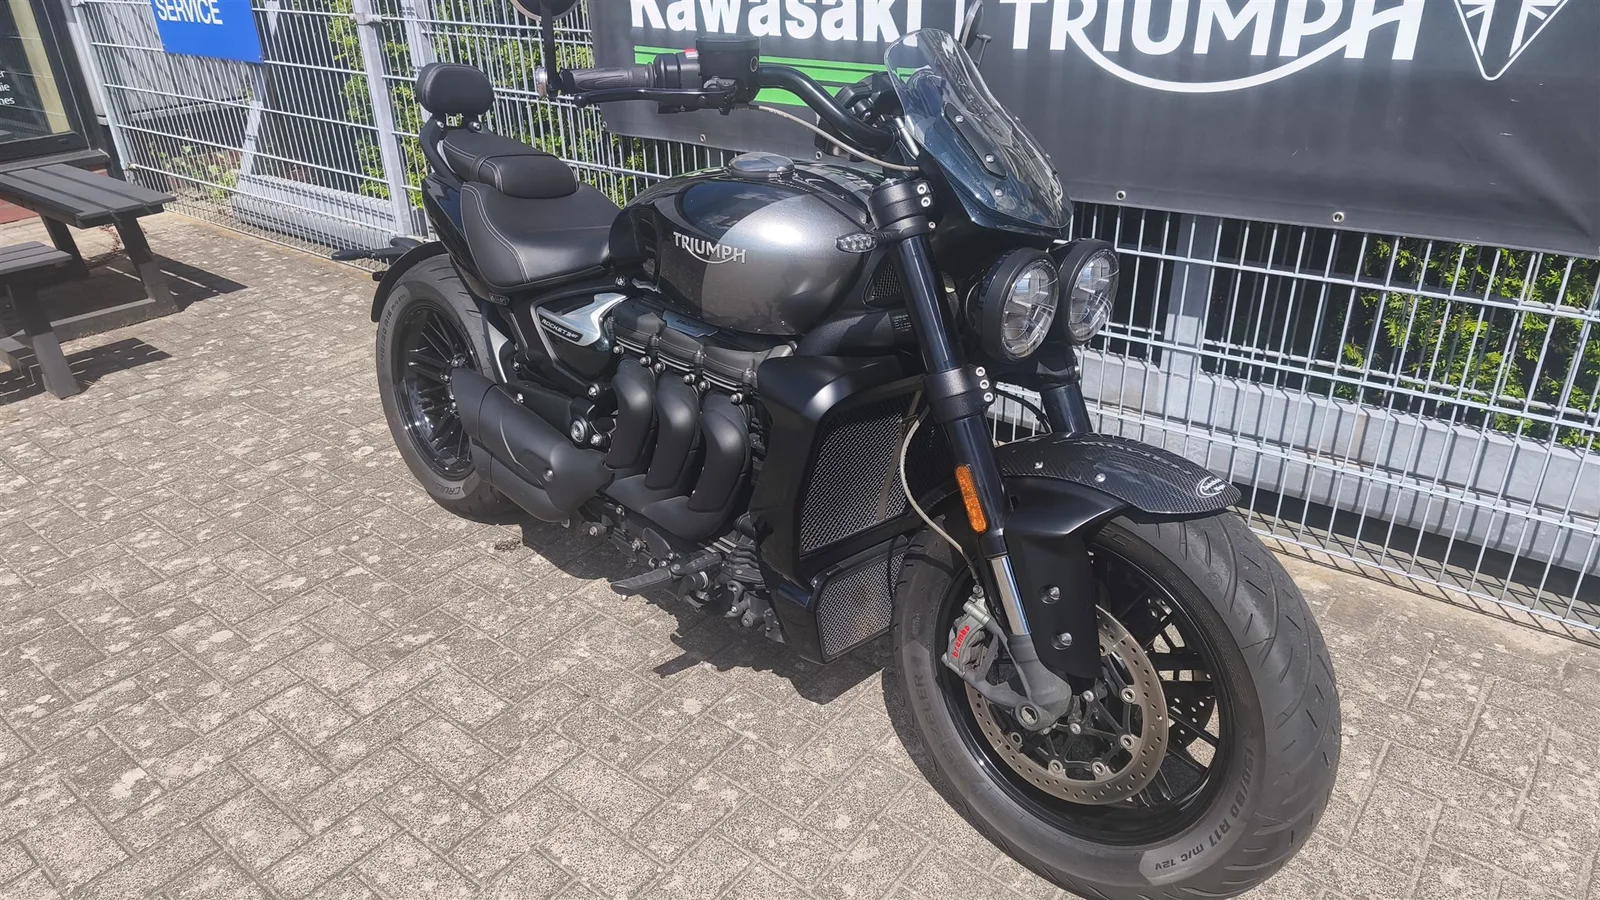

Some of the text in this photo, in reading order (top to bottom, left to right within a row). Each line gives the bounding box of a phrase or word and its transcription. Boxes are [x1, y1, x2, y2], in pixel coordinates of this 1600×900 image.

[155, 0, 223, 25] SERVICE
[1000, 0, 1426, 93] TRIUMPH
[673, 231, 746, 264] TRIUMPH
[952, 624, 971, 659] brembo
[1208, 817, 1232, 847] R17
